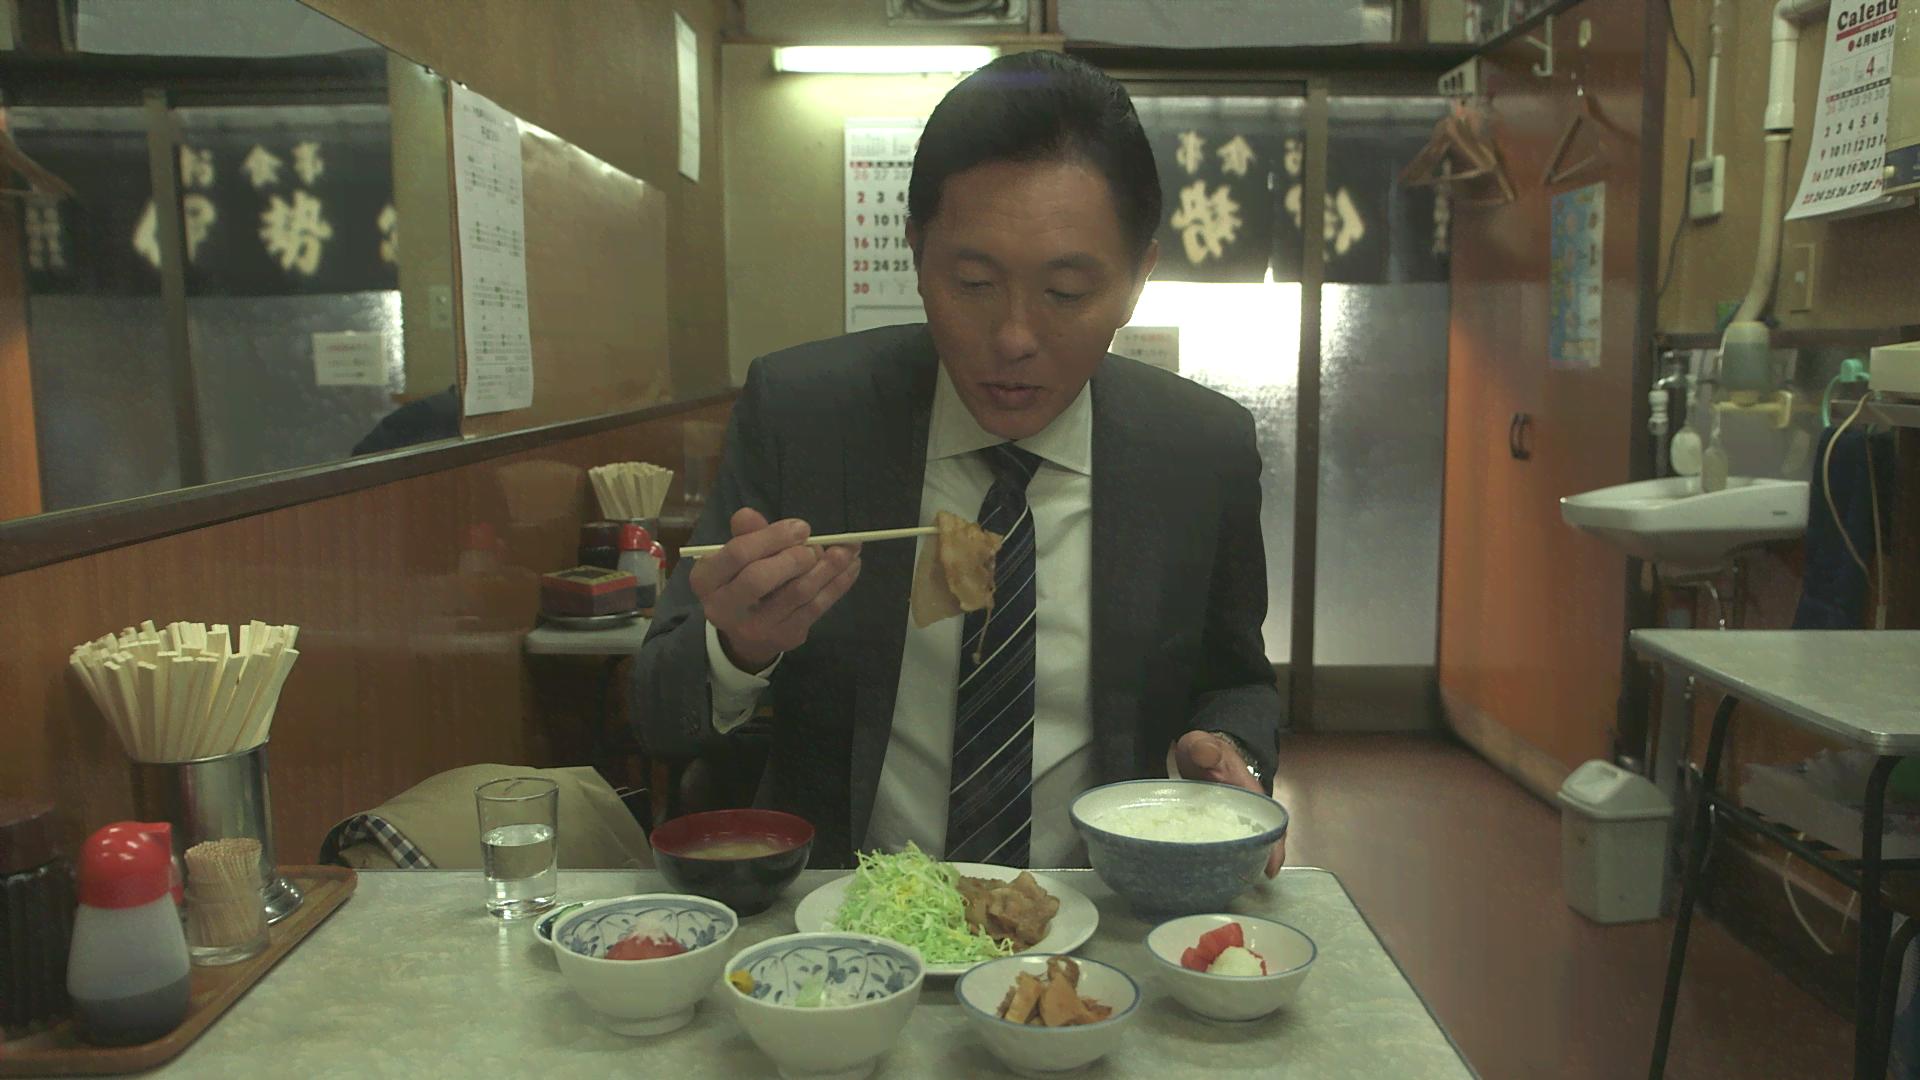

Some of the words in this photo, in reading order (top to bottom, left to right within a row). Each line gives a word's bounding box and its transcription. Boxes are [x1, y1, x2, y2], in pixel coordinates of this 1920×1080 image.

[1865, 57, 1875, 76] 4
[1825, 127, 1830, 138] 2
[1836, 124, 1842, 135] 3
[1848, 119, 1854, 131] 4
[1860, 115, 1866, 128] 5
[1873, 112, 1879, 124] 6
[1820, 149, 1826, 161] 9
[1831, 145, 1840, 157] 10
[1842, 142, 1850, 154] 11
[1854, 140, 1864, 152] 12
[1866, 136, 1877, 148] 13
[1812, 171, 1821, 183] 16
[1823, 167, 1834, 179] 17
[1834, 166, 1846, 178] 18
[1847, 163, 1856, 176] 19
[1857, 160, 1869, 173] 20
[1870, 157, 1882, 170] 21
[857, 191, 865, 203] 2
[877, 191, 884, 203] 3
[896, 191, 905, 203] 4
[1802, 193, 1814, 205] 23
[1813, 190, 1825, 202] 24
[1824, 188, 1837, 200] 25
[1836, 186, 1848, 198] 26
[1848, 183, 1860, 195] 27
[1859, 180, 1872, 192] 28
[857, 214, 865, 226] 9
[874, 213, 890, 226] 10
[854, 237, 869, 249] 16
[874, 237, 889, 249] 17
[894, 237, 908, 249] 18
[853, 260, 869, 272] 23
[873, 260, 889, 272] 24
[893, 260, 909, 272] 25
[853, 282, 870, 294] 30
